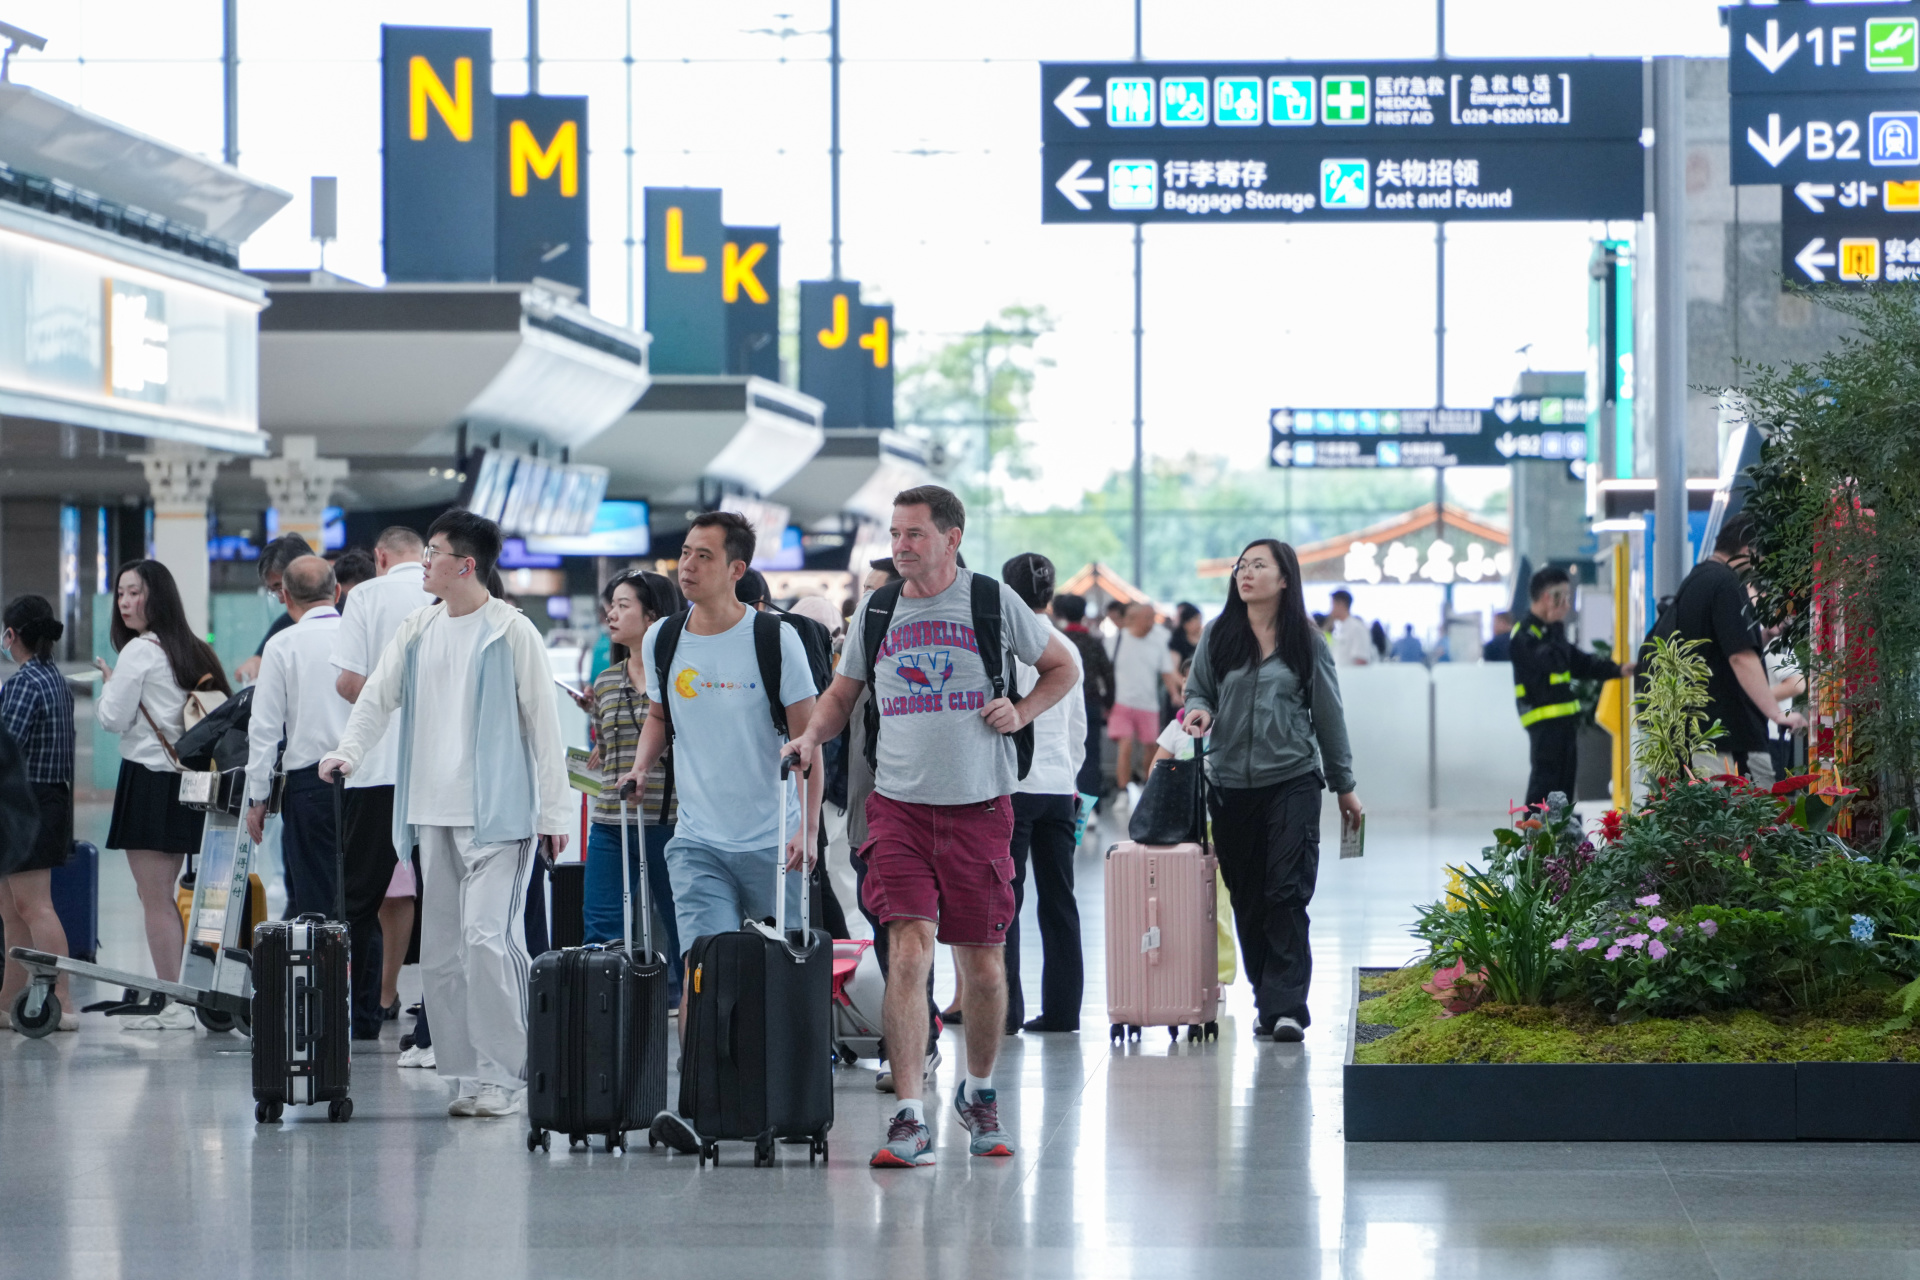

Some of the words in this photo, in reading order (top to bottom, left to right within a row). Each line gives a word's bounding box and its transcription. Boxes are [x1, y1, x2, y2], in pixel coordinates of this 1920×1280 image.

[1805, 27, 1856, 66] 1F
[409, 55, 473, 142] N
[1375, 97, 1432, 110] MEDICAL
[1470, 93, 1528, 107] Emergency
[1529, 92, 1551, 105] Call
[1375, 111, 1410, 125] FIRST
[1410, 111, 1435, 125] AID
[1806, 120, 1861, 160] B2
[510, 120, 577, 197] M
[1163, 160, 1268, 188] 行李寄存
[1375, 159, 1479, 187] 失物招领
[1163, 190, 1243, 214] Baggage
[1245, 190, 1316, 213] Storage
[1375, 189, 1415, 208] Lost
[1417, 189, 1452, 208] and
[1455, 188, 1512, 208] Found
[666, 207, 707, 273] L
[722, 242, 769, 304] K
[817, 294, 849, 349] J
[881, 694, 943, 716] LACROSSE
[948, 691, 985, 711] CLUB
